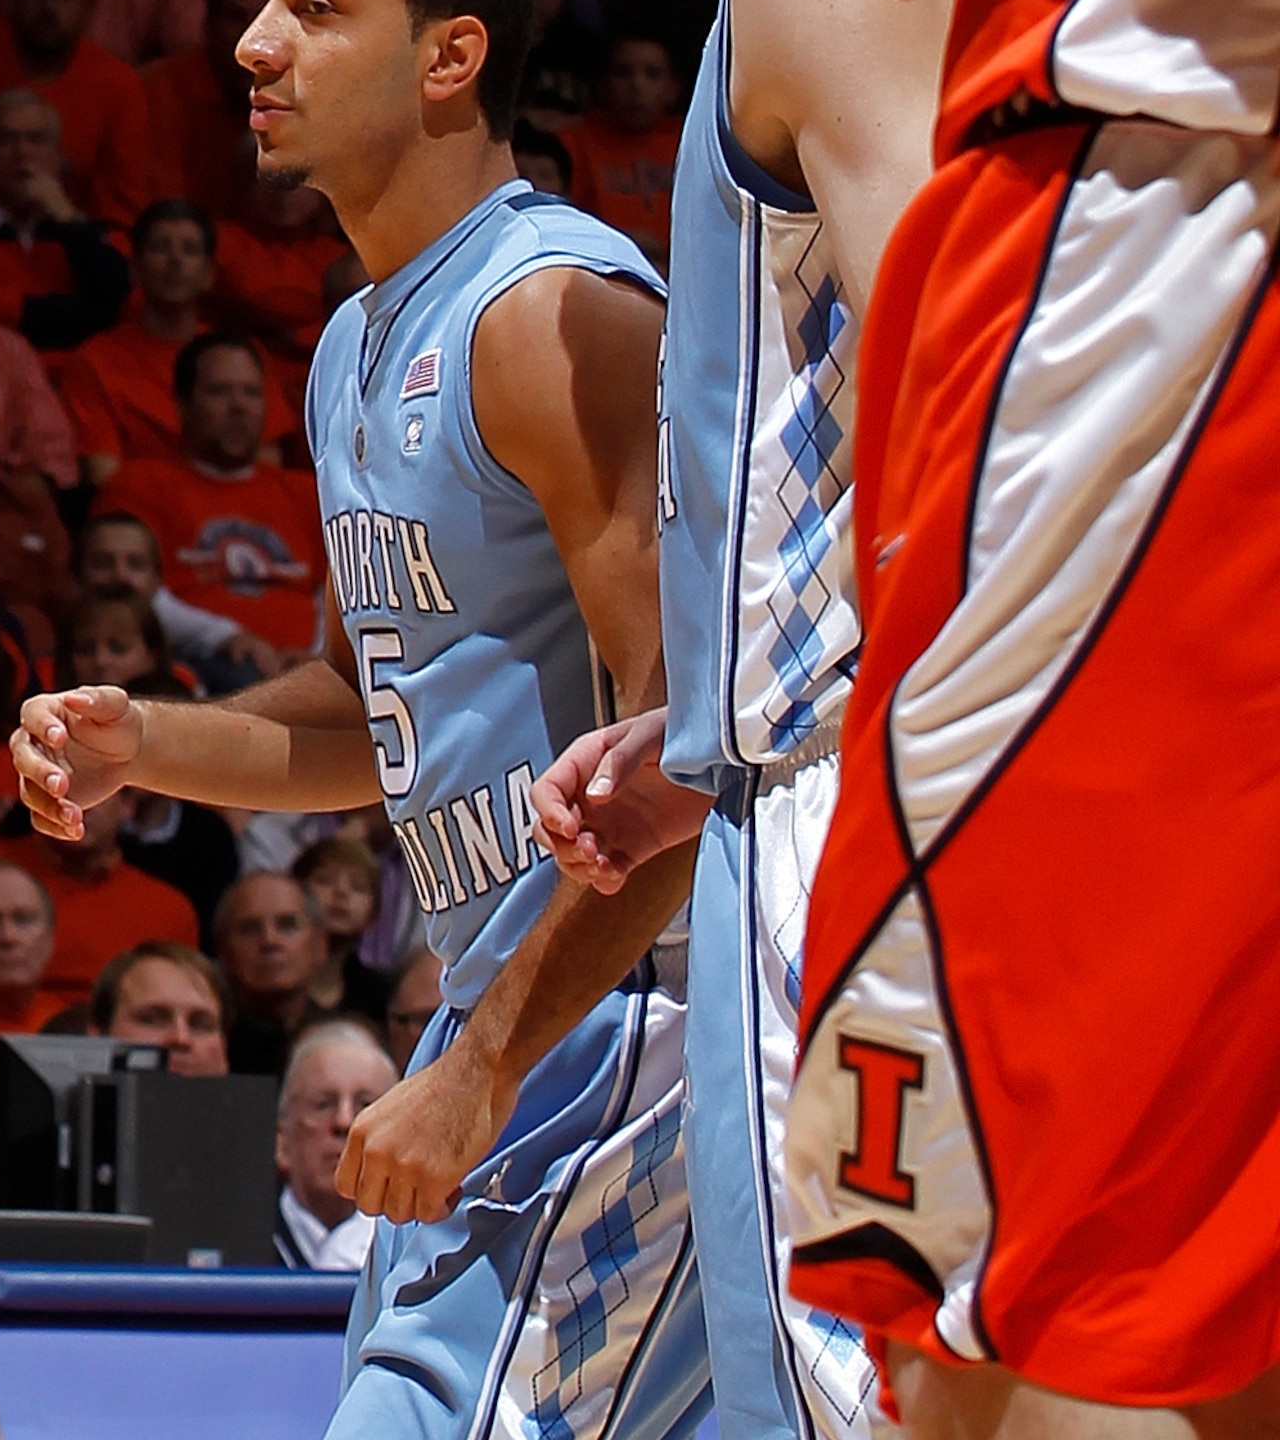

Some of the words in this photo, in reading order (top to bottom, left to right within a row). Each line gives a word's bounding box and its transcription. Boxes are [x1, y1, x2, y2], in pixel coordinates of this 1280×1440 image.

[325, 508, 458, 615] NORTH
[359, 627, 419, 800] 5
[840, 1033, 925, 1211] I
